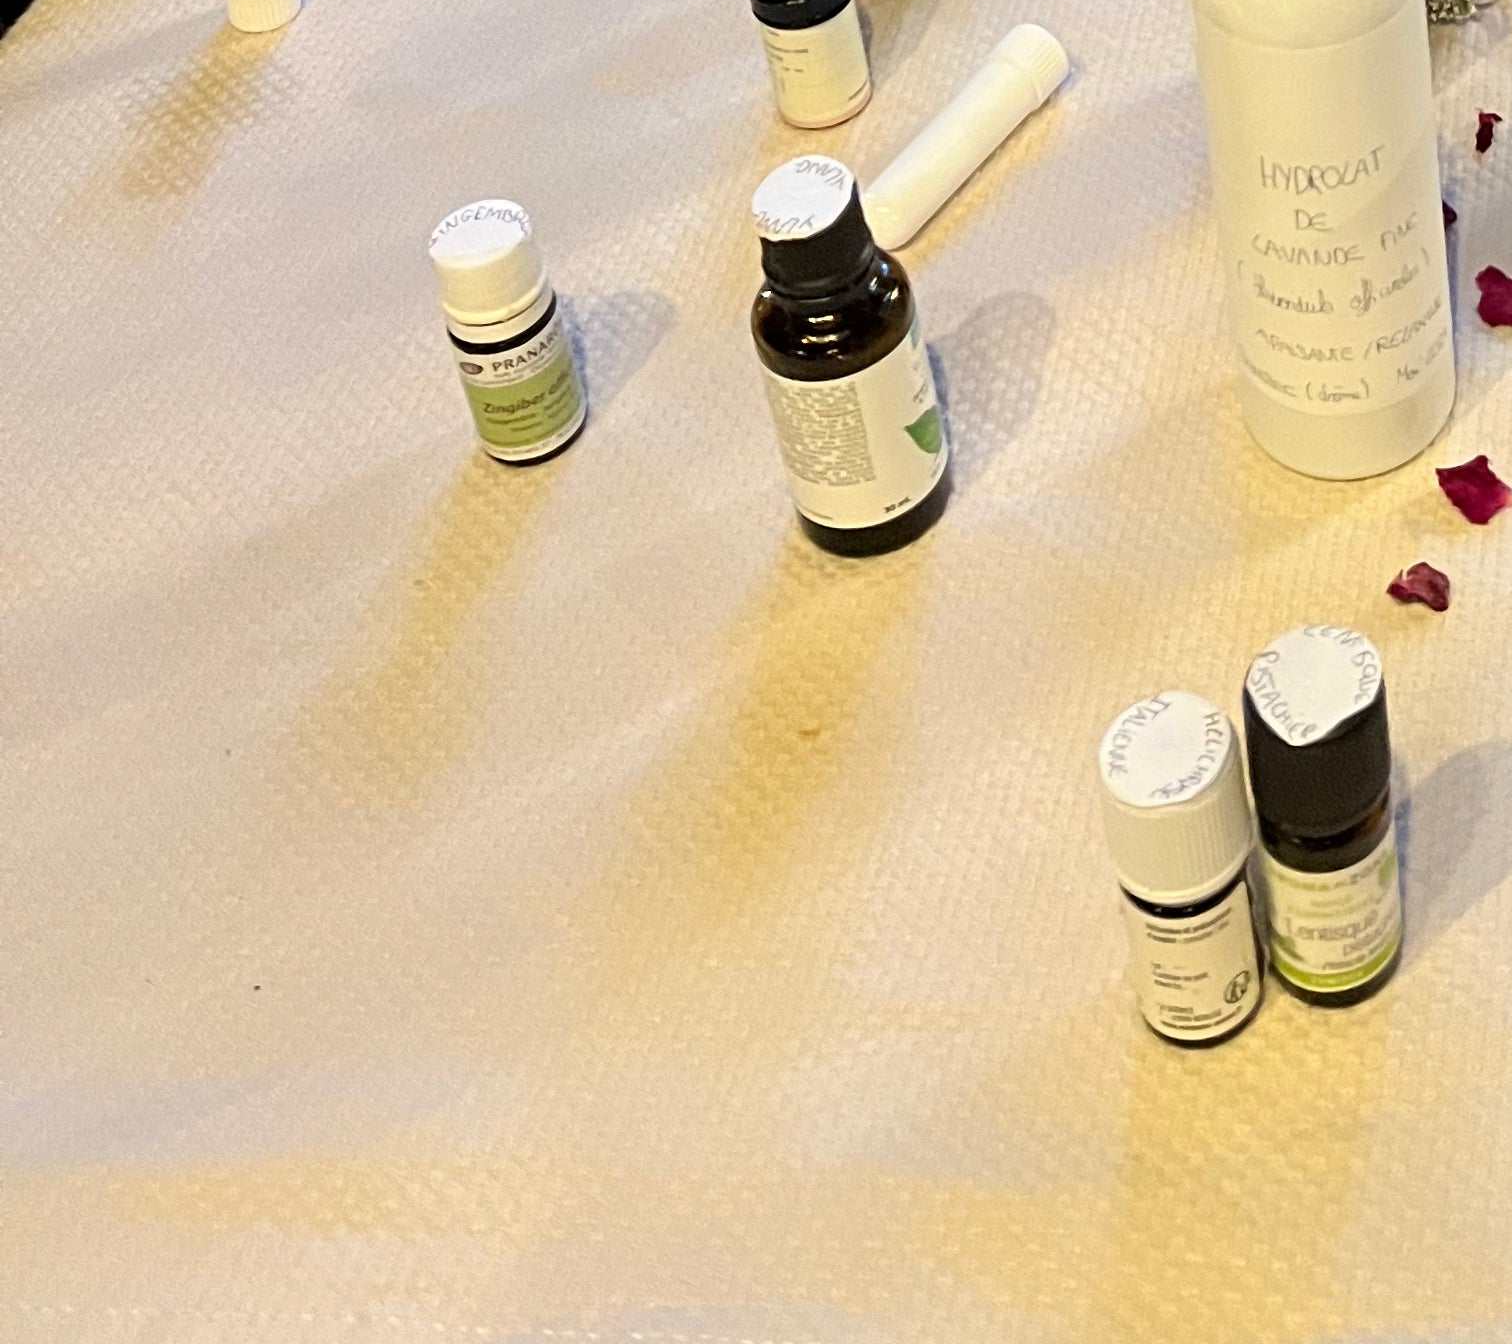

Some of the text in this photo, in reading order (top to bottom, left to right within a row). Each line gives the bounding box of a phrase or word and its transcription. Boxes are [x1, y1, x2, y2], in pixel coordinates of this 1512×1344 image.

[1260, 145, 1385, 195] HYDROLAT
[1295, 208, 1333, 232] DE
[1253, 233, 1365, 266] LAVANDE
[492, 320, 559, 372] PRANAR
